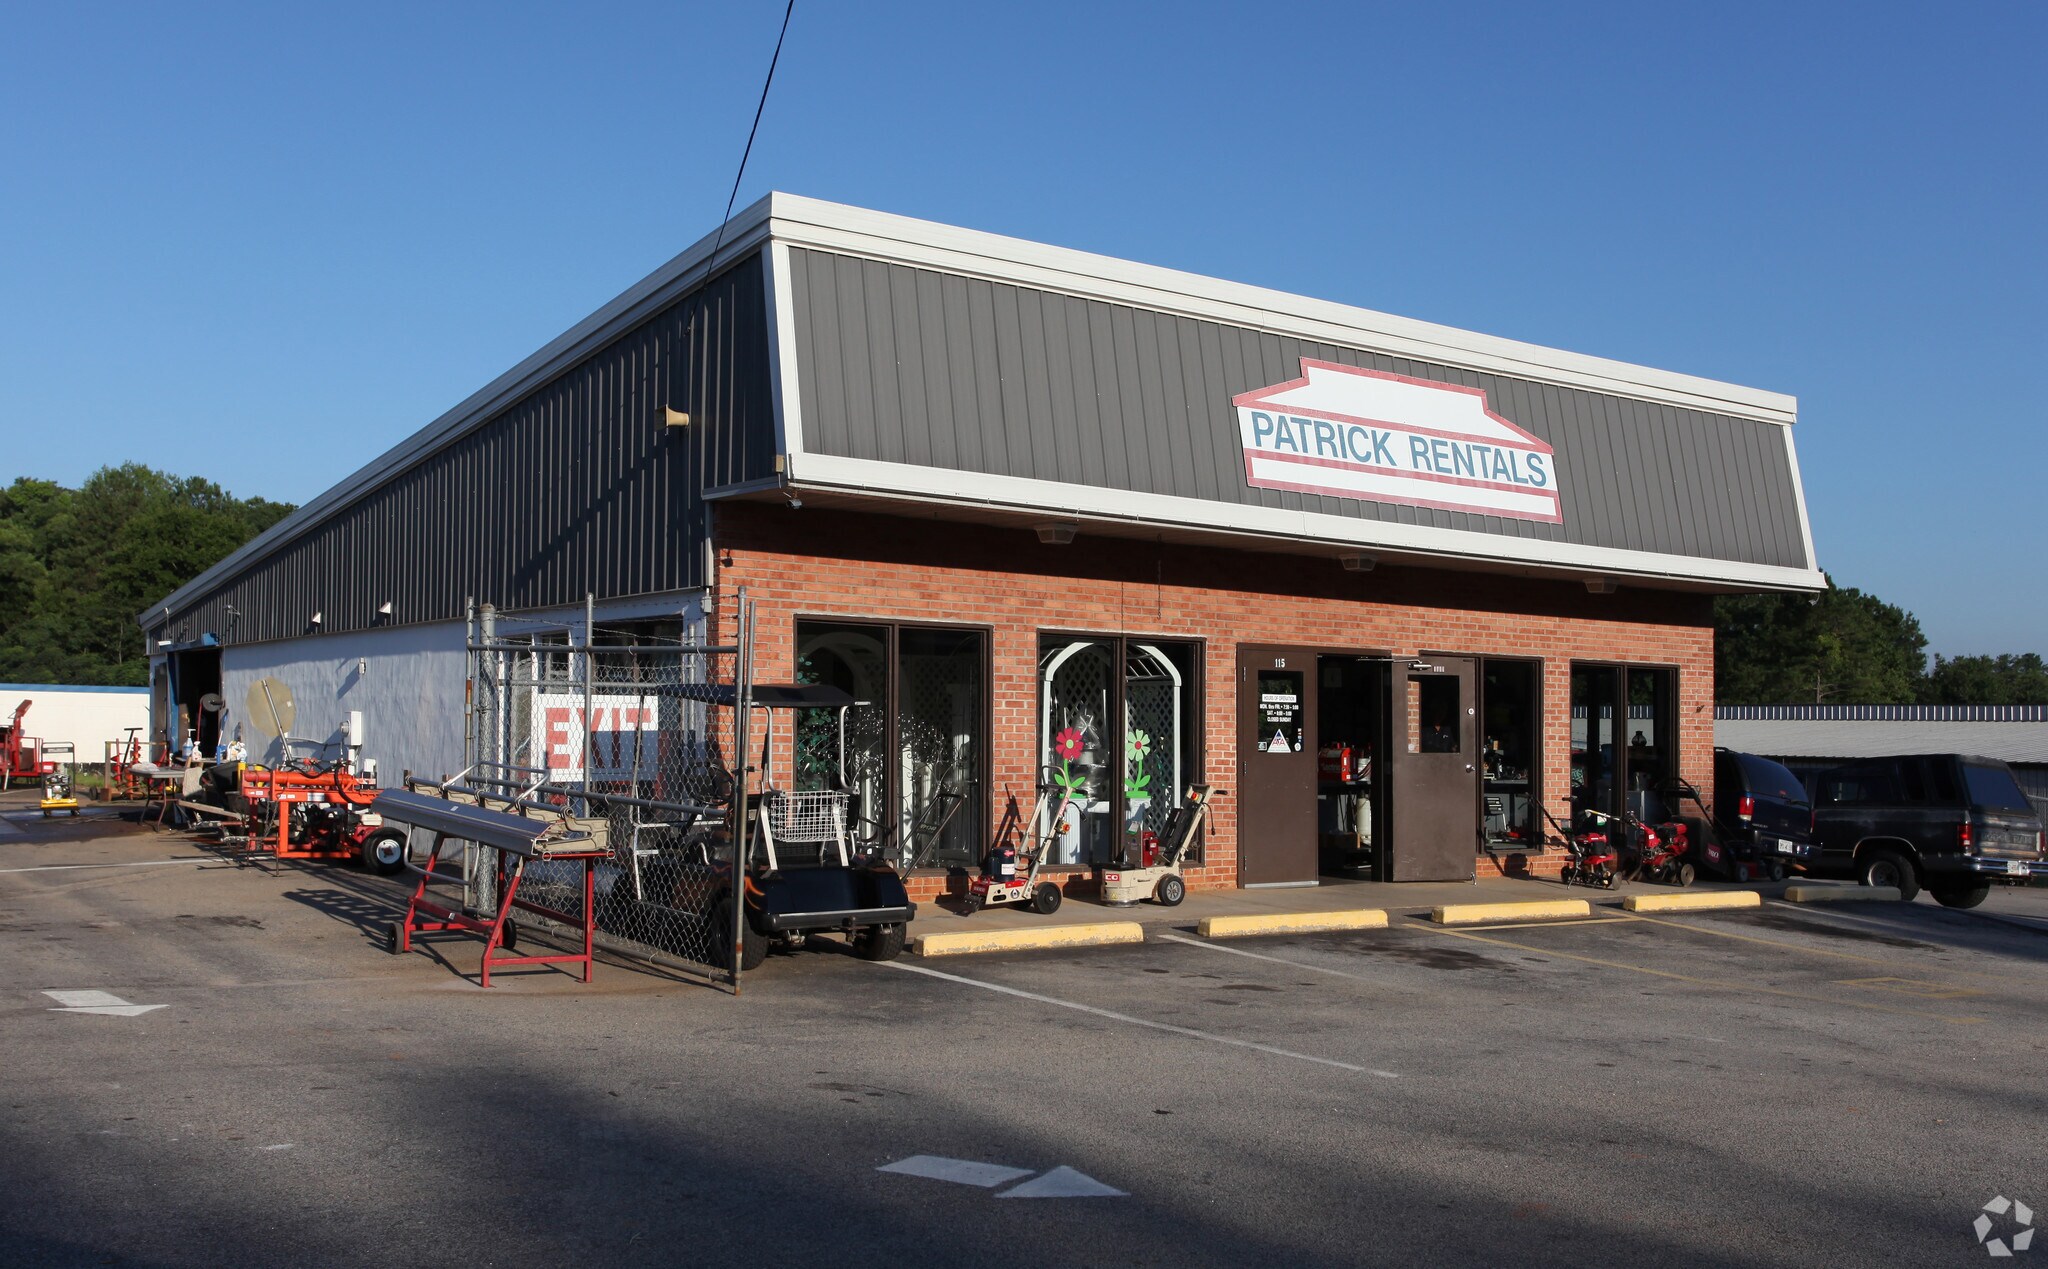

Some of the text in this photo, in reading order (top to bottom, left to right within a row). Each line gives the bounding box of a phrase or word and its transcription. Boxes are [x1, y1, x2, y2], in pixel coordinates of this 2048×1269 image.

[1251, 411, 1547, 487] PATRICK RENTALS
[1275, 658, 1286, 668] 115
[545, 707, 651, 769] EXIT
